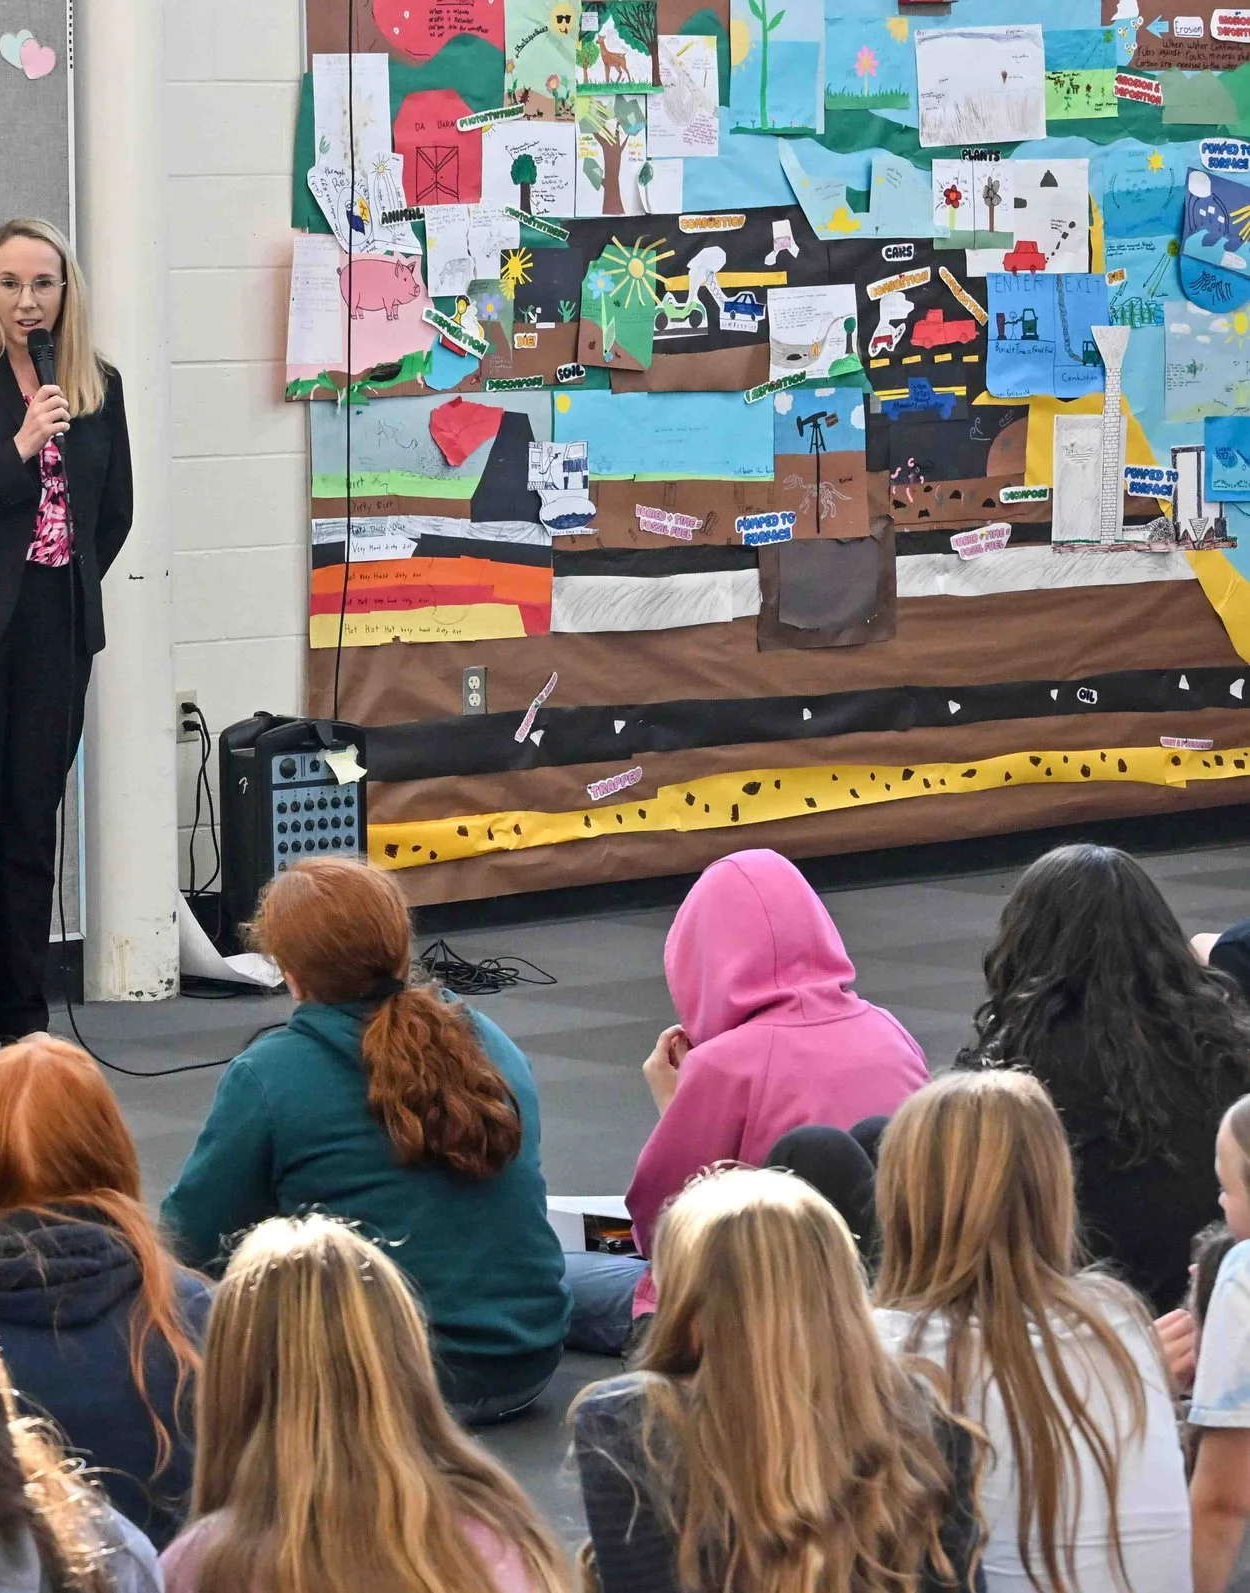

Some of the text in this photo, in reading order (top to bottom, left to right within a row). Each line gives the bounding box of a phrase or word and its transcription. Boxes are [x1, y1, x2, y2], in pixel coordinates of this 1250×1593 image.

[1175, 20, 1203, 34] Erosion
[1162, 39, 1185, 48] When
[1116, 74, 1153, 91] EROSION
[1114, 85, 1162, 105] DEPOSITION
[415, 122, 425, 132] DA
[962, 149, 1000, 162] PLANTS
[1201, 142, 1239, 155] PUMPED
[1208, 156, 1249, 170] SURFACE
[381, 207, 425, 225] ANIMAL
[680, 216, 745, 230] COMBUSTION
[884, 245, 913, 259] CARS
[869, 271, 929, 299] COMBUSTION
[994, 274, 1045, 293] ENTER
[1065, 275, 1102, 294] EXIT
[940, 268, 988, 324] COMBUSTION
[424, 309, 489, 355] RESPIRATION
[515, 335, 537, 348] DIE!
[557, 363, 585, 381] SOIL
[1061, 372, 1098, 383] Combustion
[487, 375, 544, 391] DECOMPOSE
[1124, 467, 1179, 483] PUMPED TO
[1129, 481, 1173, 497] SURFACE
[636, 505, 667, 522] BURIED
[674, 513, 697, 529] TIME
[736, 511, 796, 532] PUMPED TO
[640, 519, 693, 540] FOSSIL FUEL
[744, 527, 791, 545] SURFACE
[984, 539, 1006, 552] FUEL
[344, 623, 357, 634] Hot
[365, 624, 379, 634] Hot
[384, 623, 395, 633] Hot
[1079, 689, 1095, 702] OIL
[590, 768, 642, 799] TRAPPED
